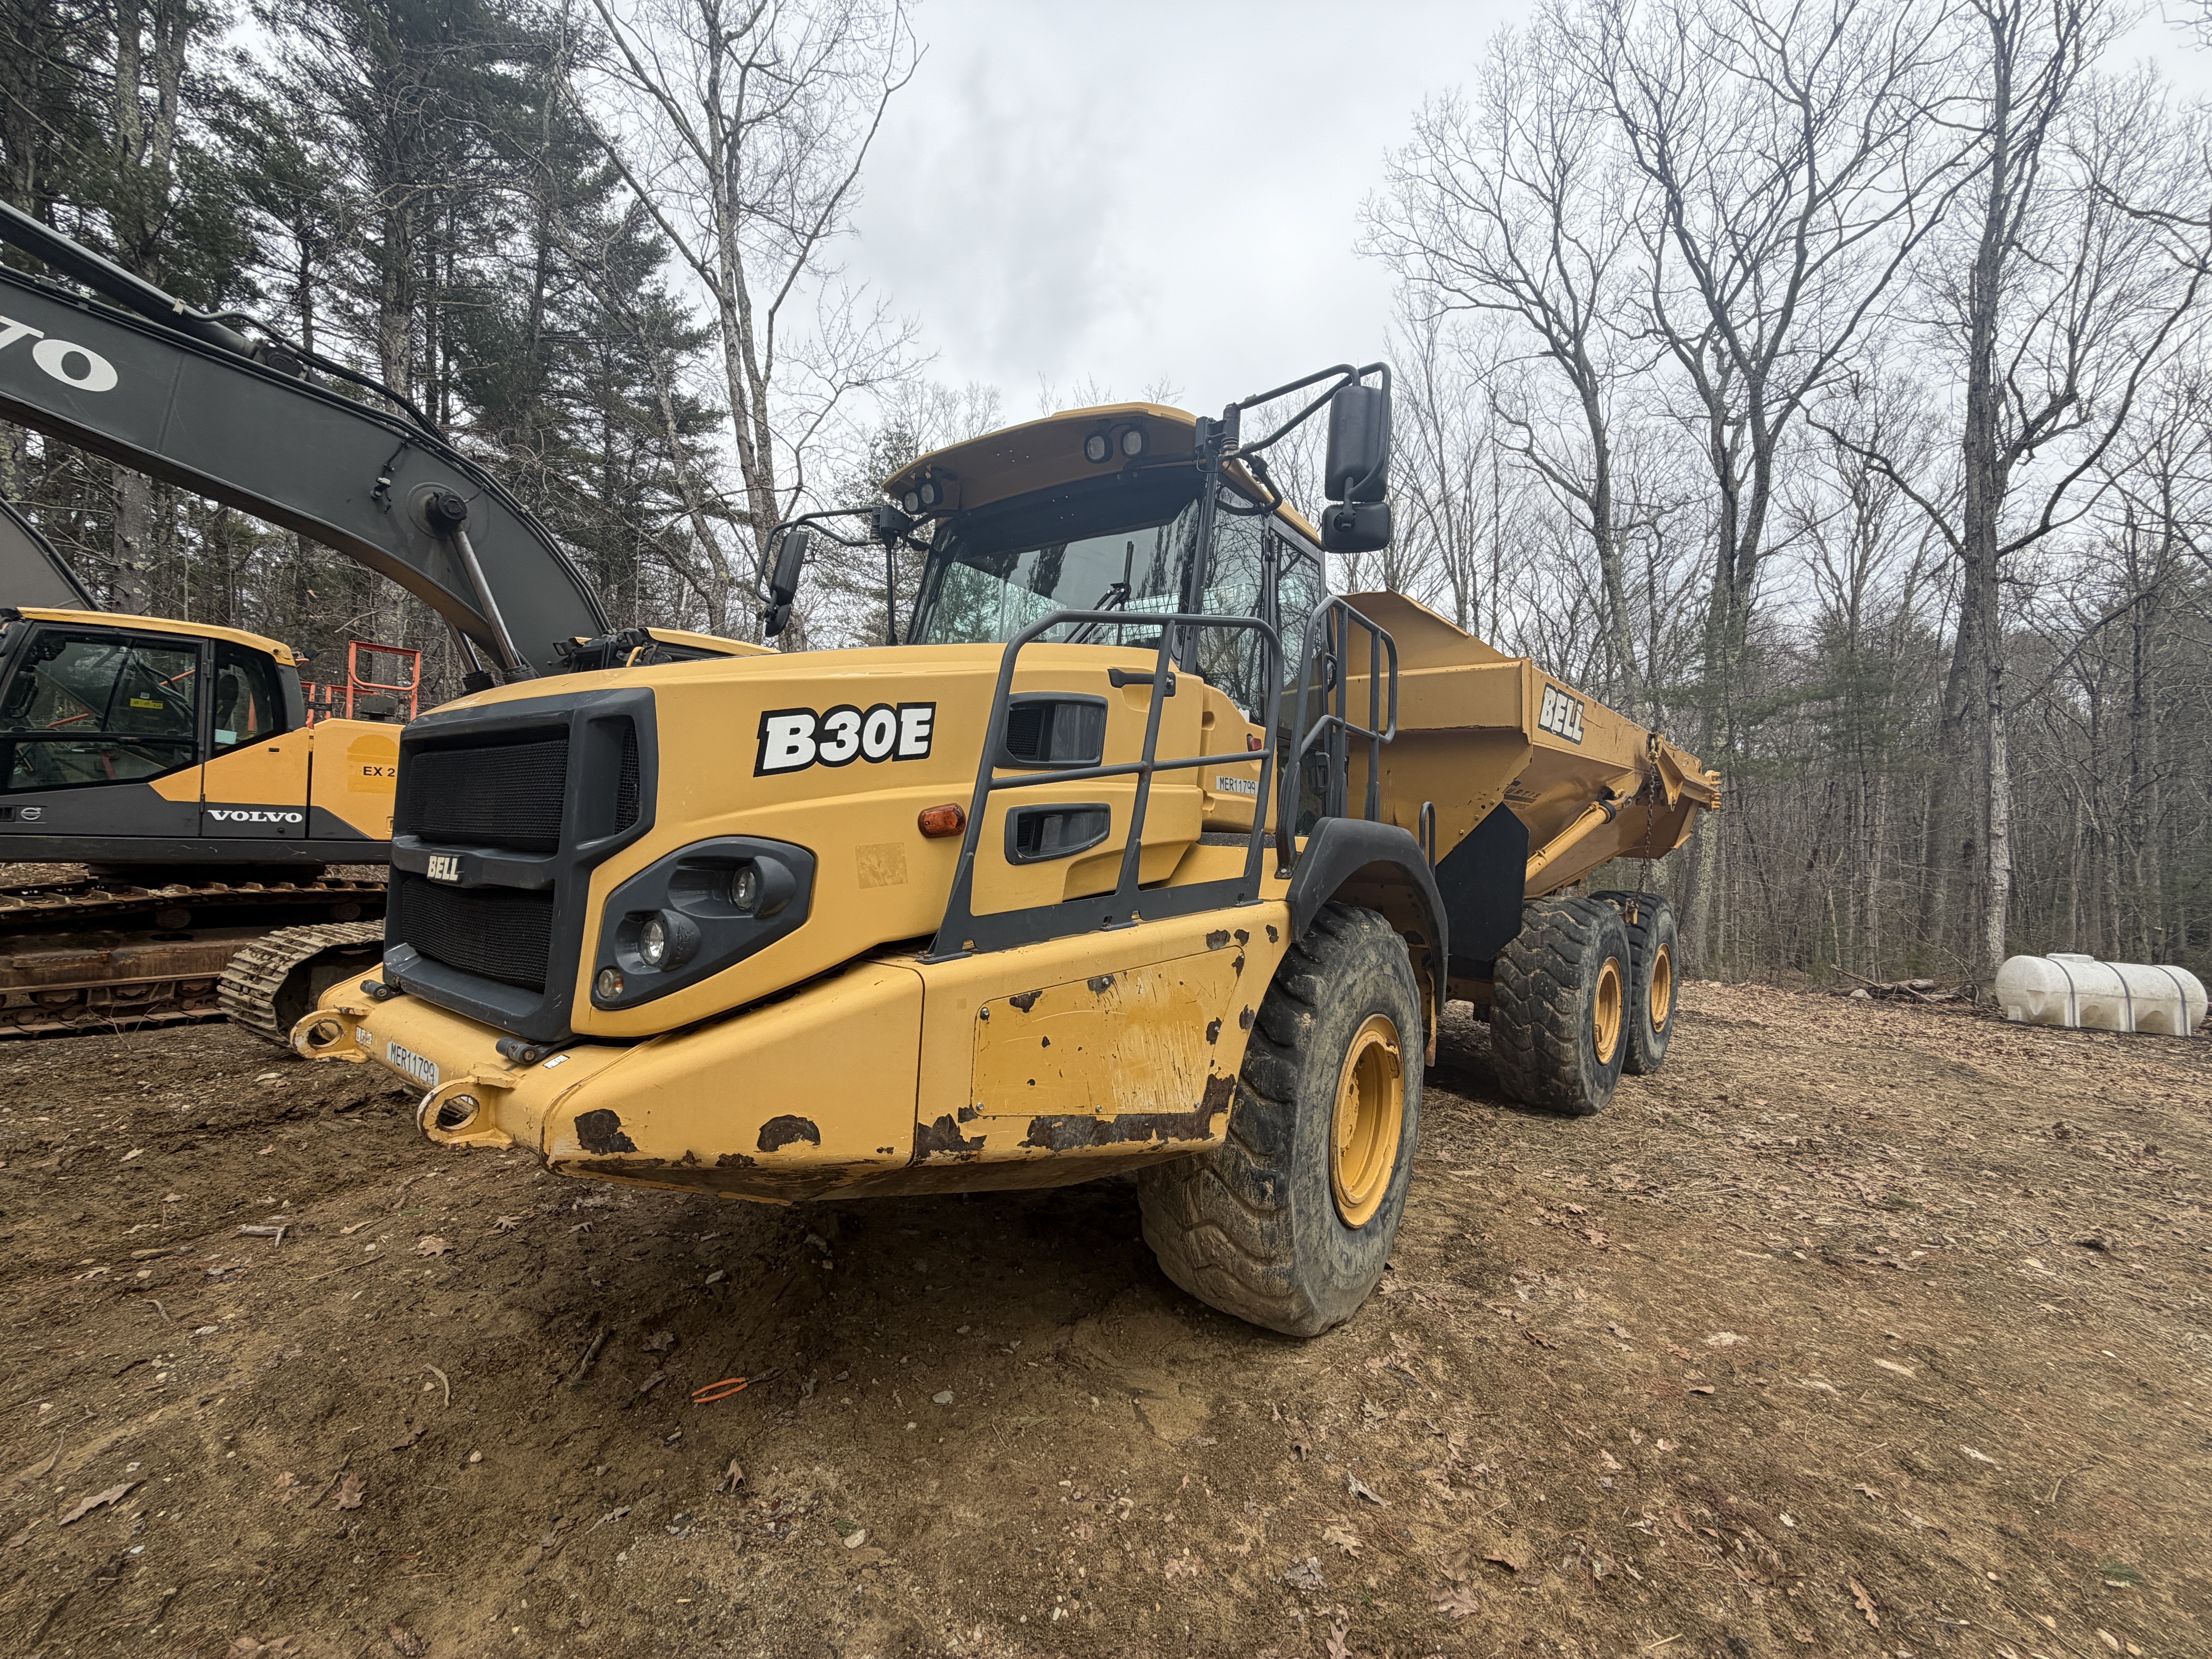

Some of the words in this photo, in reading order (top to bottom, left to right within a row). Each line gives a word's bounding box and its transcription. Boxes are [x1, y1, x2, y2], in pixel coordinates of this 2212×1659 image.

[1539, 686, 1582, 742] BELL
[763, 708, 932, 770] B30E
[363, 766, 383, 776] EX
[387, 768, 395, 777] 2
[1219, 776, 1256, 794] MER11799
[207, 810, 303, 823] VOLVO
[427, 855, 459, 881] BELL
[390, 1042, 435, 1085] MER11799
